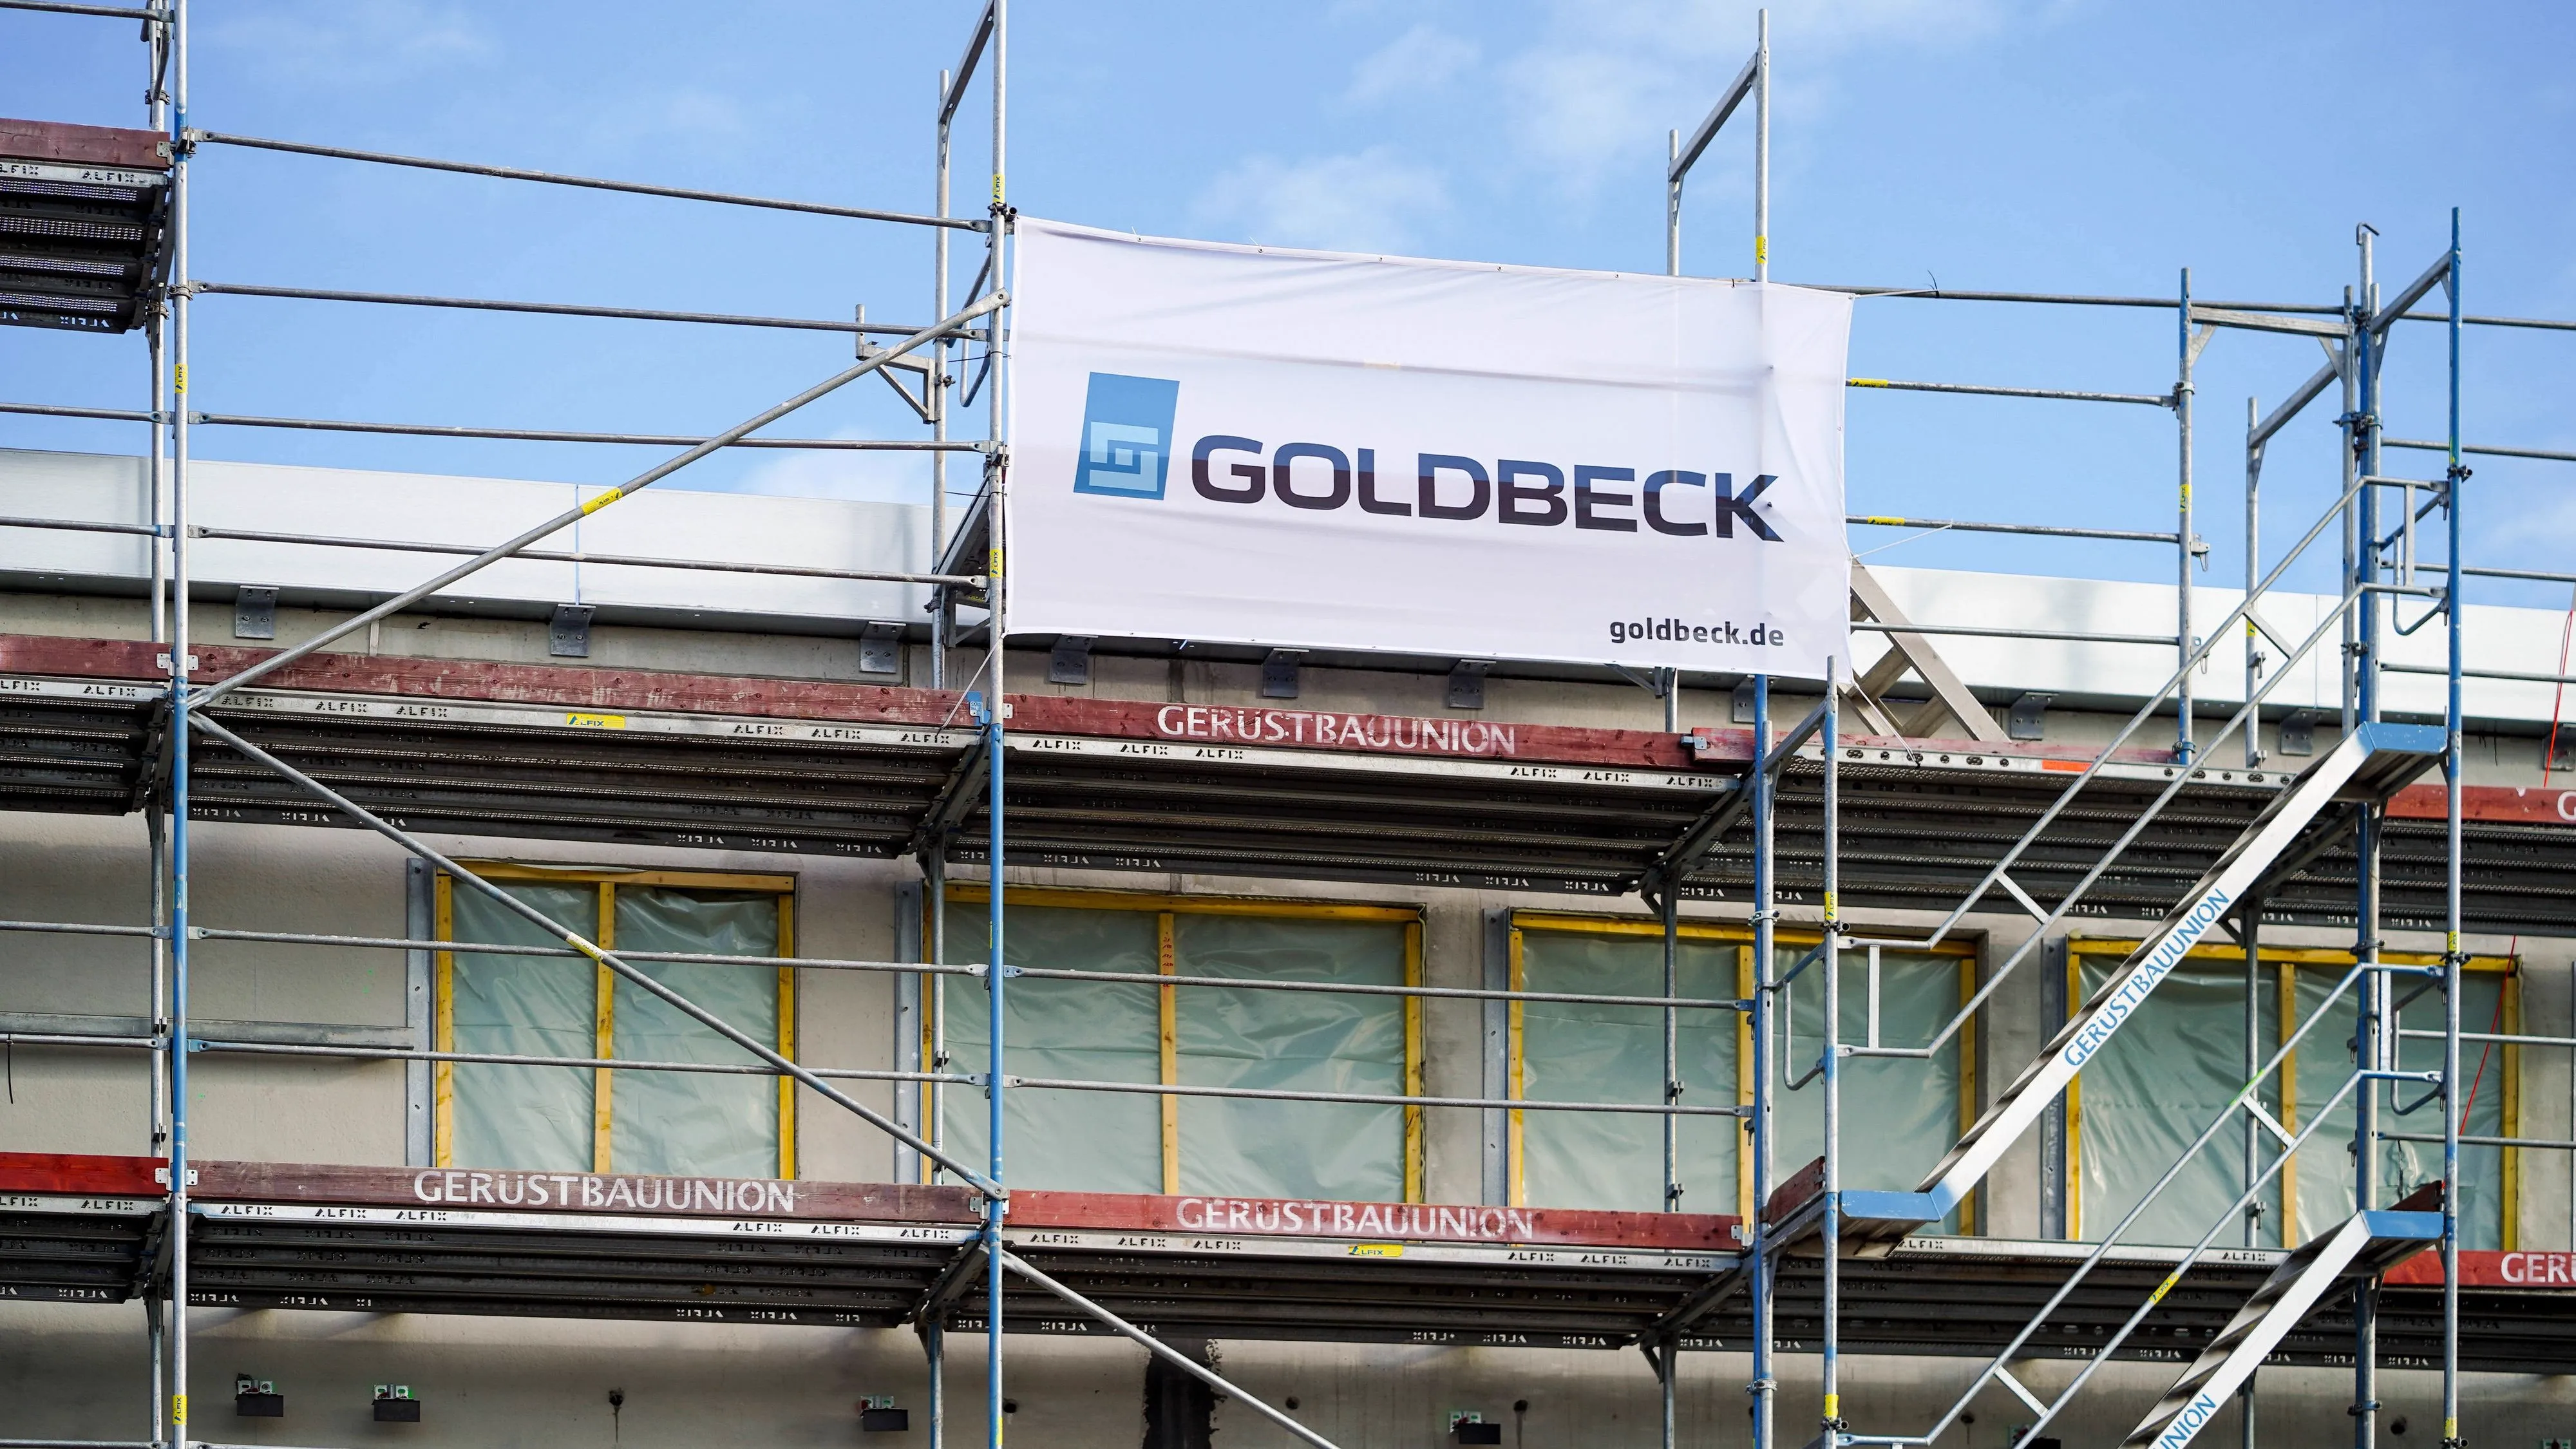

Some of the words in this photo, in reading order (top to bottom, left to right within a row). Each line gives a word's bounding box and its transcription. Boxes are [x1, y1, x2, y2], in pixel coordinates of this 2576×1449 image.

[1191, 435, 1784, 542] GOLDBECK
[1610, 617, 1784, 646] goldbeck.de
[83, 685, 135, 697] ALFIX
[222, 696, 273, 707] ALFIX
[315, 701, 366, 712] ALFIX
[396, 706, 447, 717] ALFIX
[569, 715, 604, 726] ALFIX
[734, 724, 782, 735] ALFIX
[811, 728, 860, 739] ALFIX
[901, 734, 949, 744] ALFIX
[1032, 740, 1081, 750] ALFIX
[1121, 744, 1168, 755] ALFIX
[1195, 748, 1242, 759] ALFIX
[1511, 767, 1556, 778] ALFIX
[1583, 772, 1629, 782] ALFIX
[1667, 777, 1712, 787] ALFIX
[81, 1200, 133, 1210] ALFIX
[221, 1206, 272, 1215] ALFIX
[315, 1208, 366, 1218] ALFIX
[396, 1211, 446, 1220] ALFIX
[733, 1222, 782, 1232] ALFIX
[811, 1226, 859, 1235] ALFIX
[900, 1229, 949, 1238] ALFIX
[1030, 1234, 1078, 1244] ALFIX
[1118, 1237, 1166, 1247] ALFIX
[1193, 1240, 1240, 1249] ALFIX
[1352, 1245, 1383, 1255] ALFIX
[1508, 1253, 1554, 1262] ALFIX
[1580, 1255, 1627, 1264] ALFIX
[1664, 1258, 1710, 1267] ALFIX
[2222, 1253, 2266, 1262] ALFIX
[2154, 1394, 2217, 1449] NION
